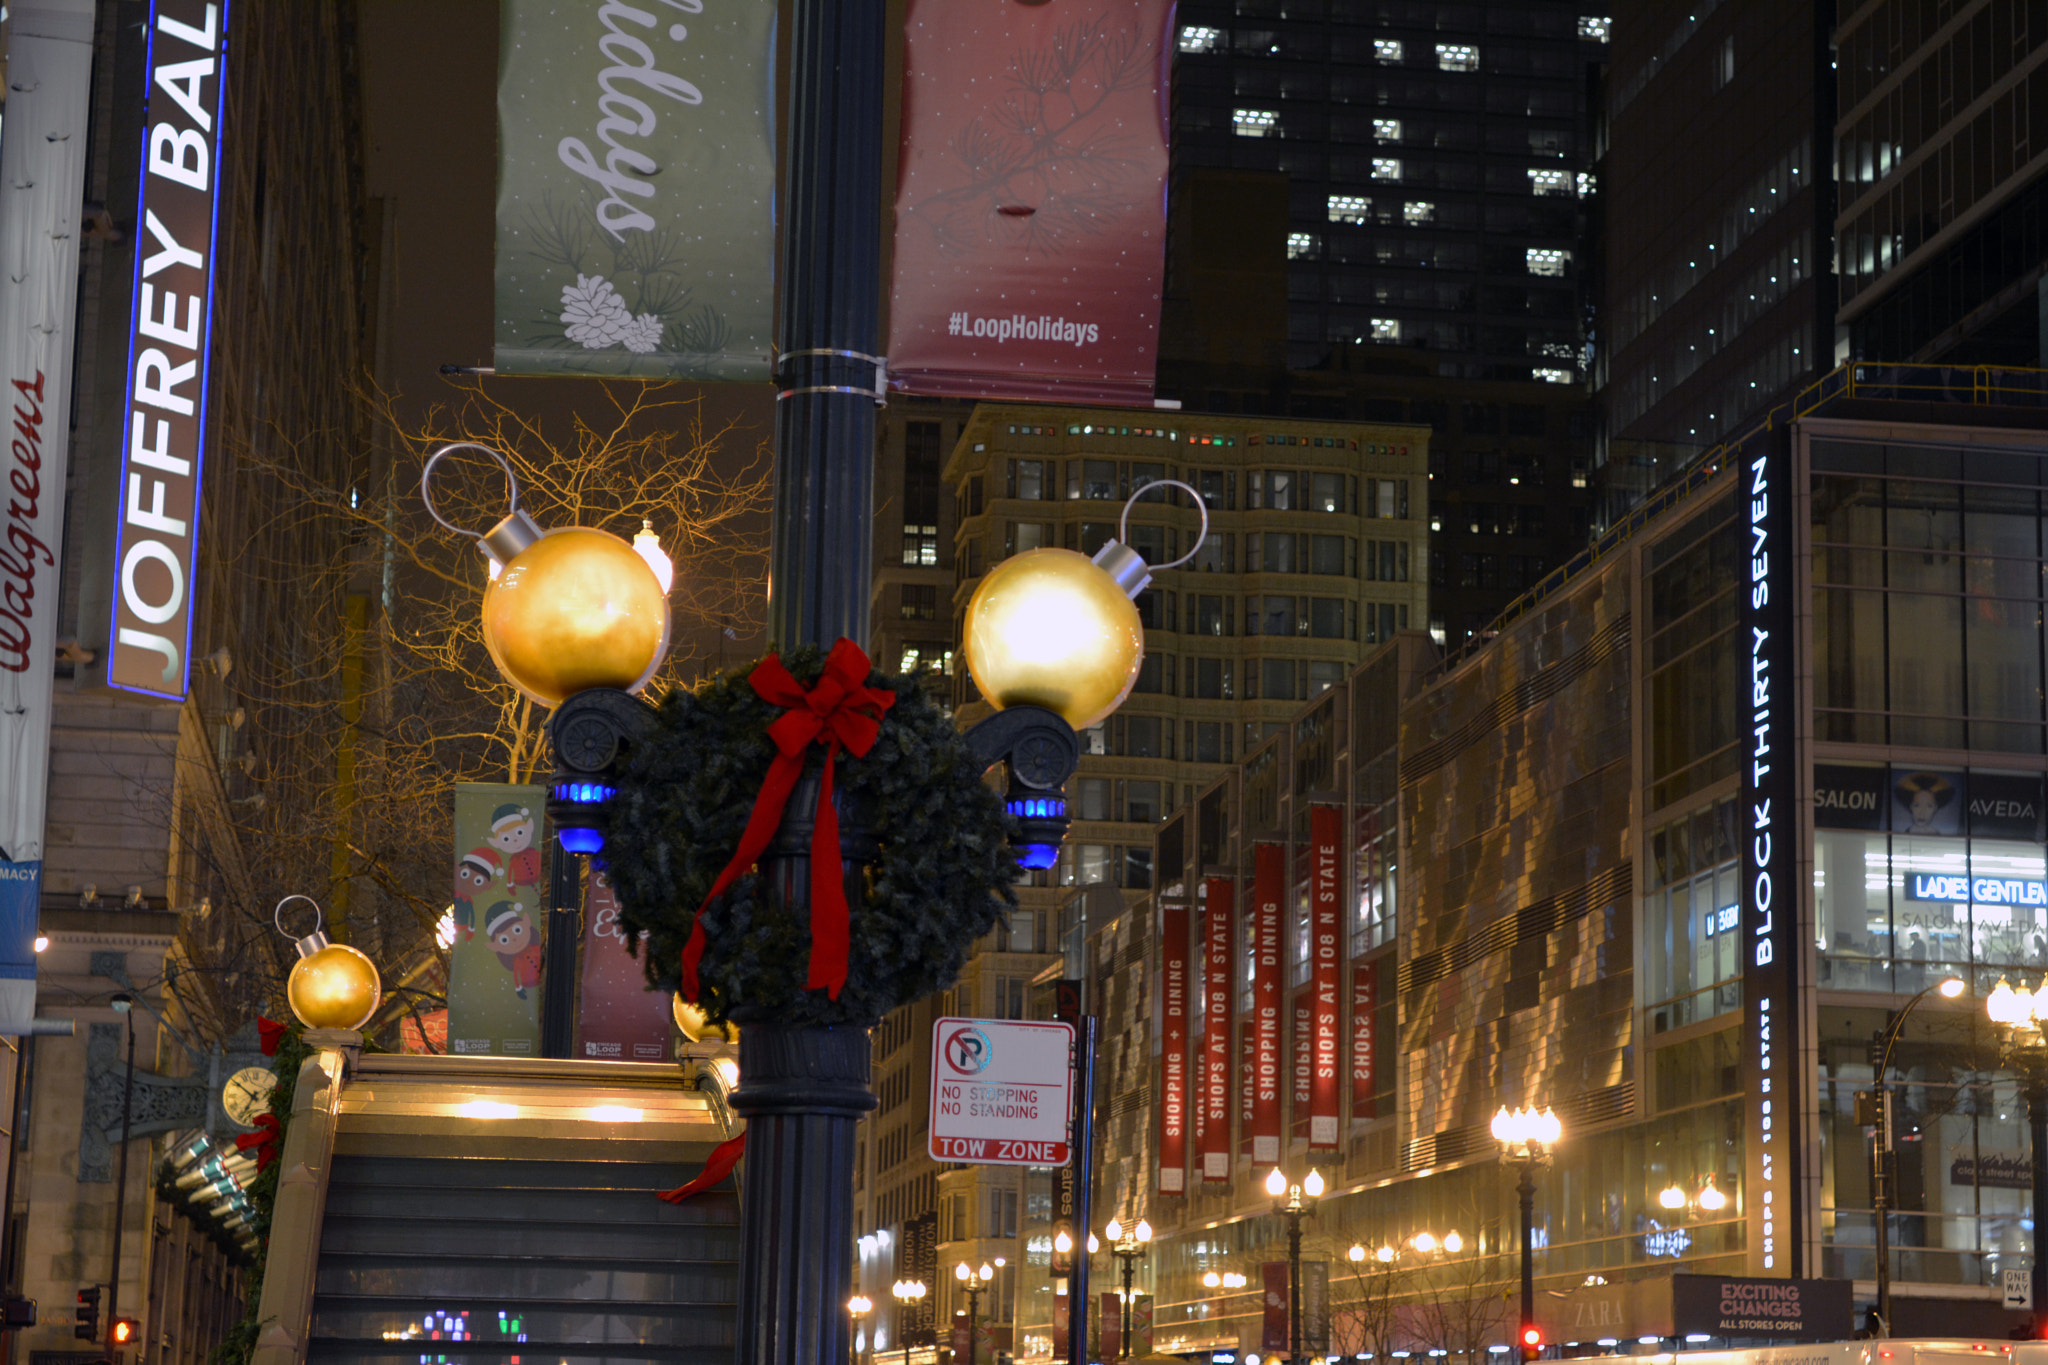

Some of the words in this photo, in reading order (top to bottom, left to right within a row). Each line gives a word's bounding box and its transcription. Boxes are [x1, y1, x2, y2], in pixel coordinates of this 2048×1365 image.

[149, 4, 217, 191] BAL
[948, 312, 1099, 345] #LoopHolidays
[117, 207, 203, 684] JOFFREY
[0, 369, 54, 673] Walgreens
[1751, 456, 1768, 609] SEVEN
[1752, 626, 1771, 787] THIRTY
[1813, 788, 1876, 810] SALON
[1969, 799, 2036, 819] AVEDA
[1319, 844, 1335, 903] STATE
[1754, 797, 1773, 966] BLOCK
[1320, 911, 1335, 924] N
[1213, 912, 1227, 964] STATE
[1262, 902, 1277, 966] DINING
[1320, 933, 1335, 970] 108
[1169, 959, 1182, 1017] DINING
[1213, 973, 1226, 984] N
[1320, 982, 1335, 1004] AT
[1212, 992, 1226, 1024] 108
[1212, 1033, 1226, 1053] AT
[1260, 1007, 1276, 1101] SHOPPING
[1318, 1013, 1335, 1079] SHOPS
[941, 1086, 961, 1100] NO
[969, 1087, 1038, 1104] STOPPING
[1166, 1052, 1182, 1137] SHOPPING
[1210, 1061, 1225, 1119] SHOPS
[941, 1102, 961, 1116] NO
[969, 1103, 1038, 1120] STANDING
[940, 1138, 986, 1158] TOW
[997, 1141, 1056, 1161] ZONE
[1721, 1283, 1800, 1301] EXCITING
[2006, 1271, 2028, 1282] ONE
[2006, 1283, 2028, 1292] WAY
[1575, 1300, 1624, 1328] ZARA
[1720, 1300, 1802, 1317] CHANGES
[1719, 1320, 1737, 1329] ALL
[1738, 1320, 1774, 1330] STORES
[1775, 1321, 1803, 1331] OPEN
